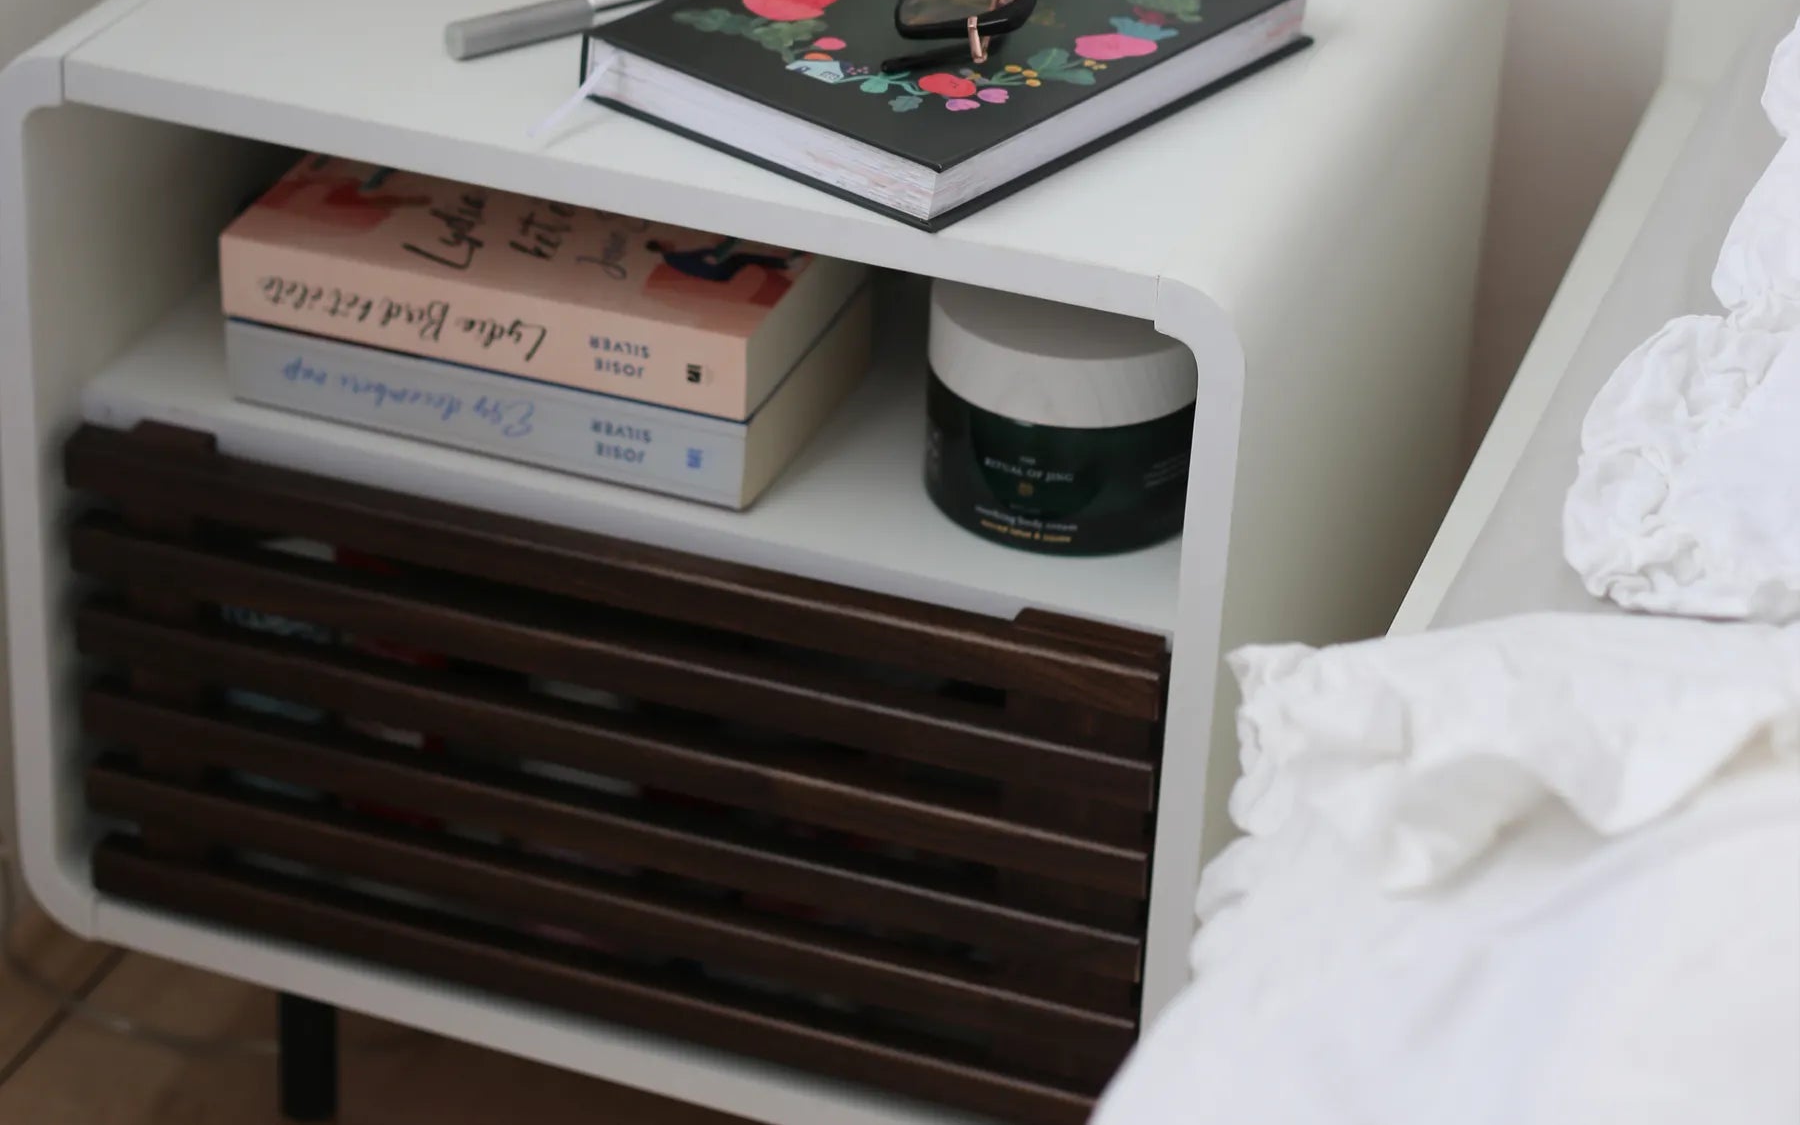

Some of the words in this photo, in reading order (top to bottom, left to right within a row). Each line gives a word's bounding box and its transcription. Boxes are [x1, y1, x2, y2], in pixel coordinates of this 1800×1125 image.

[589, 336, 651, 359] SILVER
[594, 357, 645, 378] JOSIE
[590, 419, 653, 444] SILVER
[595, 441, 646, 464] JOSIE
